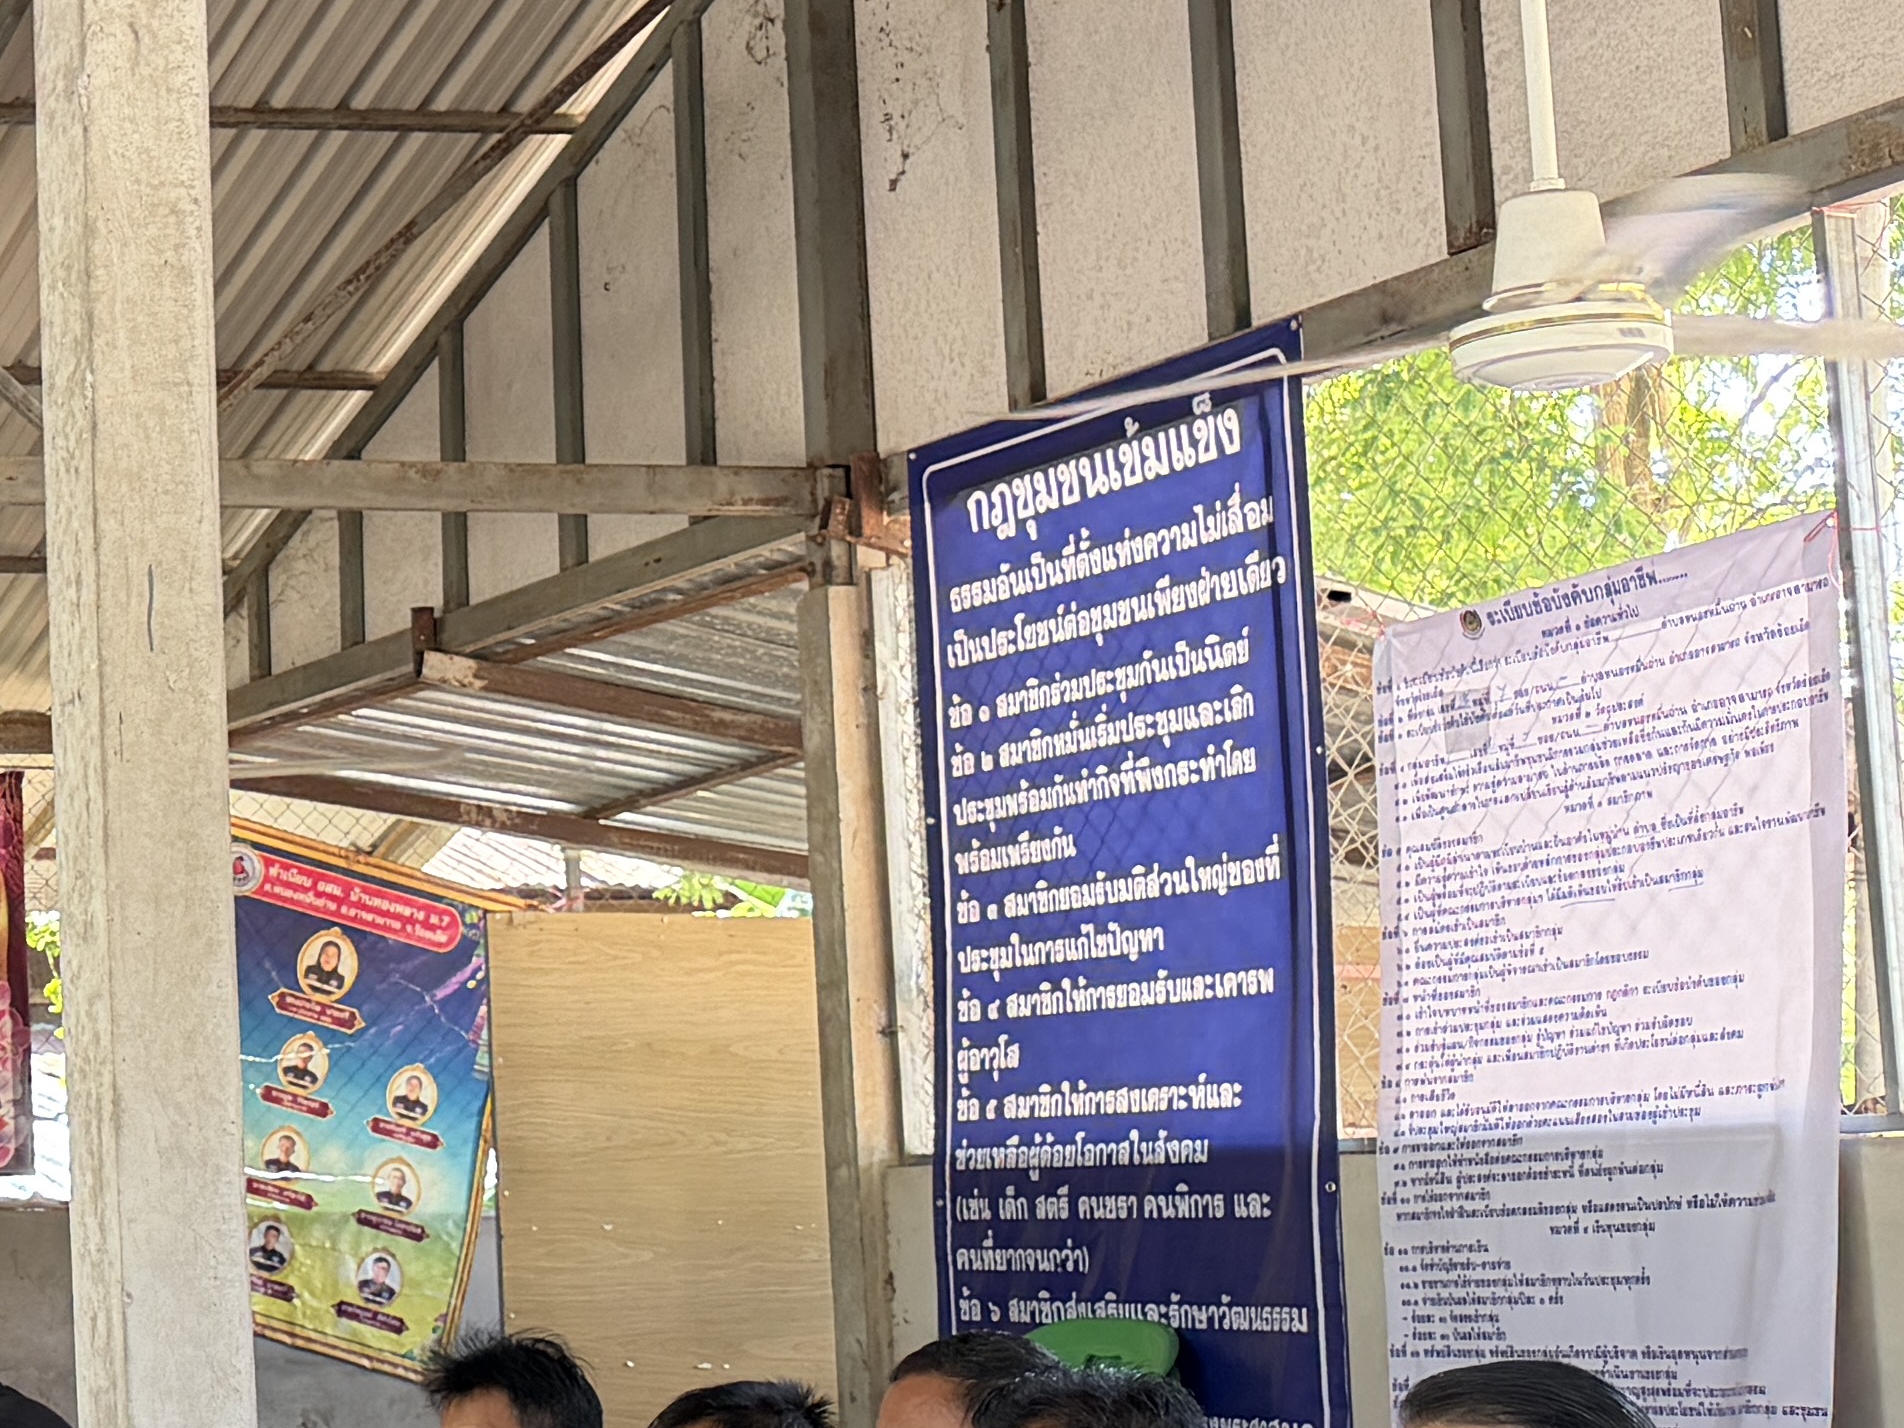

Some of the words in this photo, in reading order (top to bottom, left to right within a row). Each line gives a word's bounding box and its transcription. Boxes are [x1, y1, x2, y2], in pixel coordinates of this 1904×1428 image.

[957, 922, 1165, 982] ประชุมในการแก้ไขปัญหา
[957, 1034, 1021, 1085] ผู้อาวุโส
[1003, 1072, 1243, 1120] สมาชิกให้การสงเคราะห์และ
[955, 1128, 1210, 1181] ช่วยเหลือผู้ด้อยโอกาสในสังคม
[1035, 1184, 1071, 1220] สตรี
[1078, 1192, 1138, 1220] คนชรา
[1144, 1182, 1225, 1220] คนพิการ
[1233, 1190, 1273, 1219] และ
